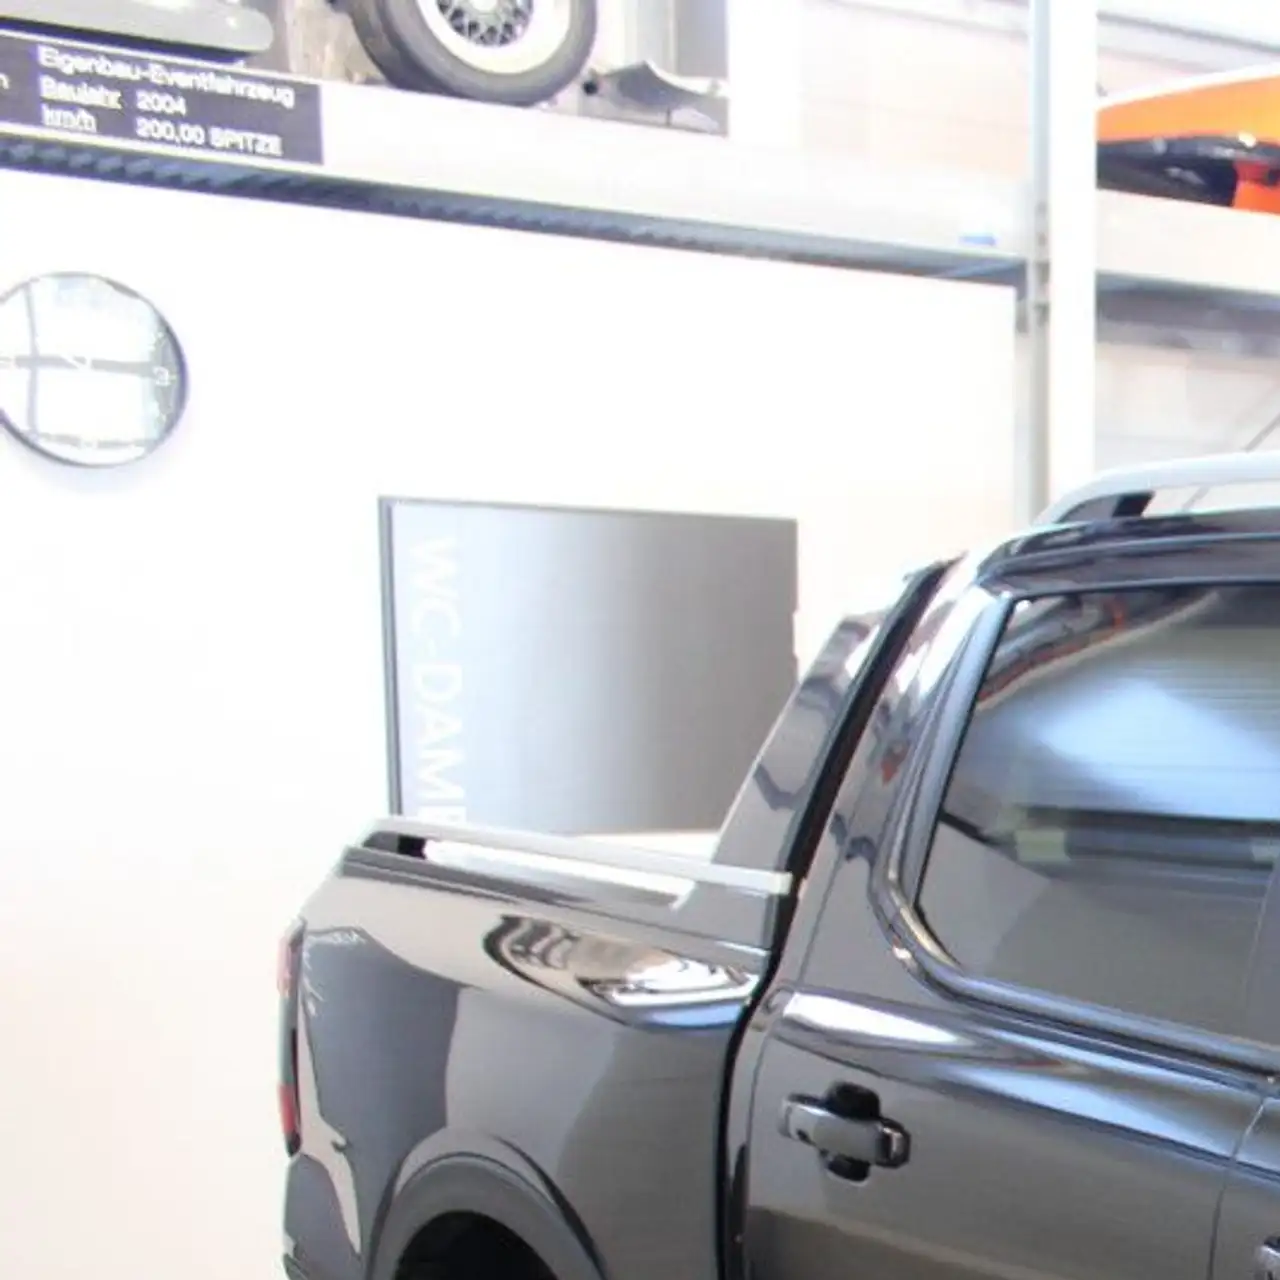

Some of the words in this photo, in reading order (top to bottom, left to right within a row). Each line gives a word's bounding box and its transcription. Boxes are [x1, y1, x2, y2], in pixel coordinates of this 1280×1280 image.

[38, 75, 123, 110] Baujahr
[135, 89, 187, 116] 2004
[41, 104, 98, 133] km/h
[135, 117, 206, 147] 200,00
[208, 125, 284, 157] SPITZE
